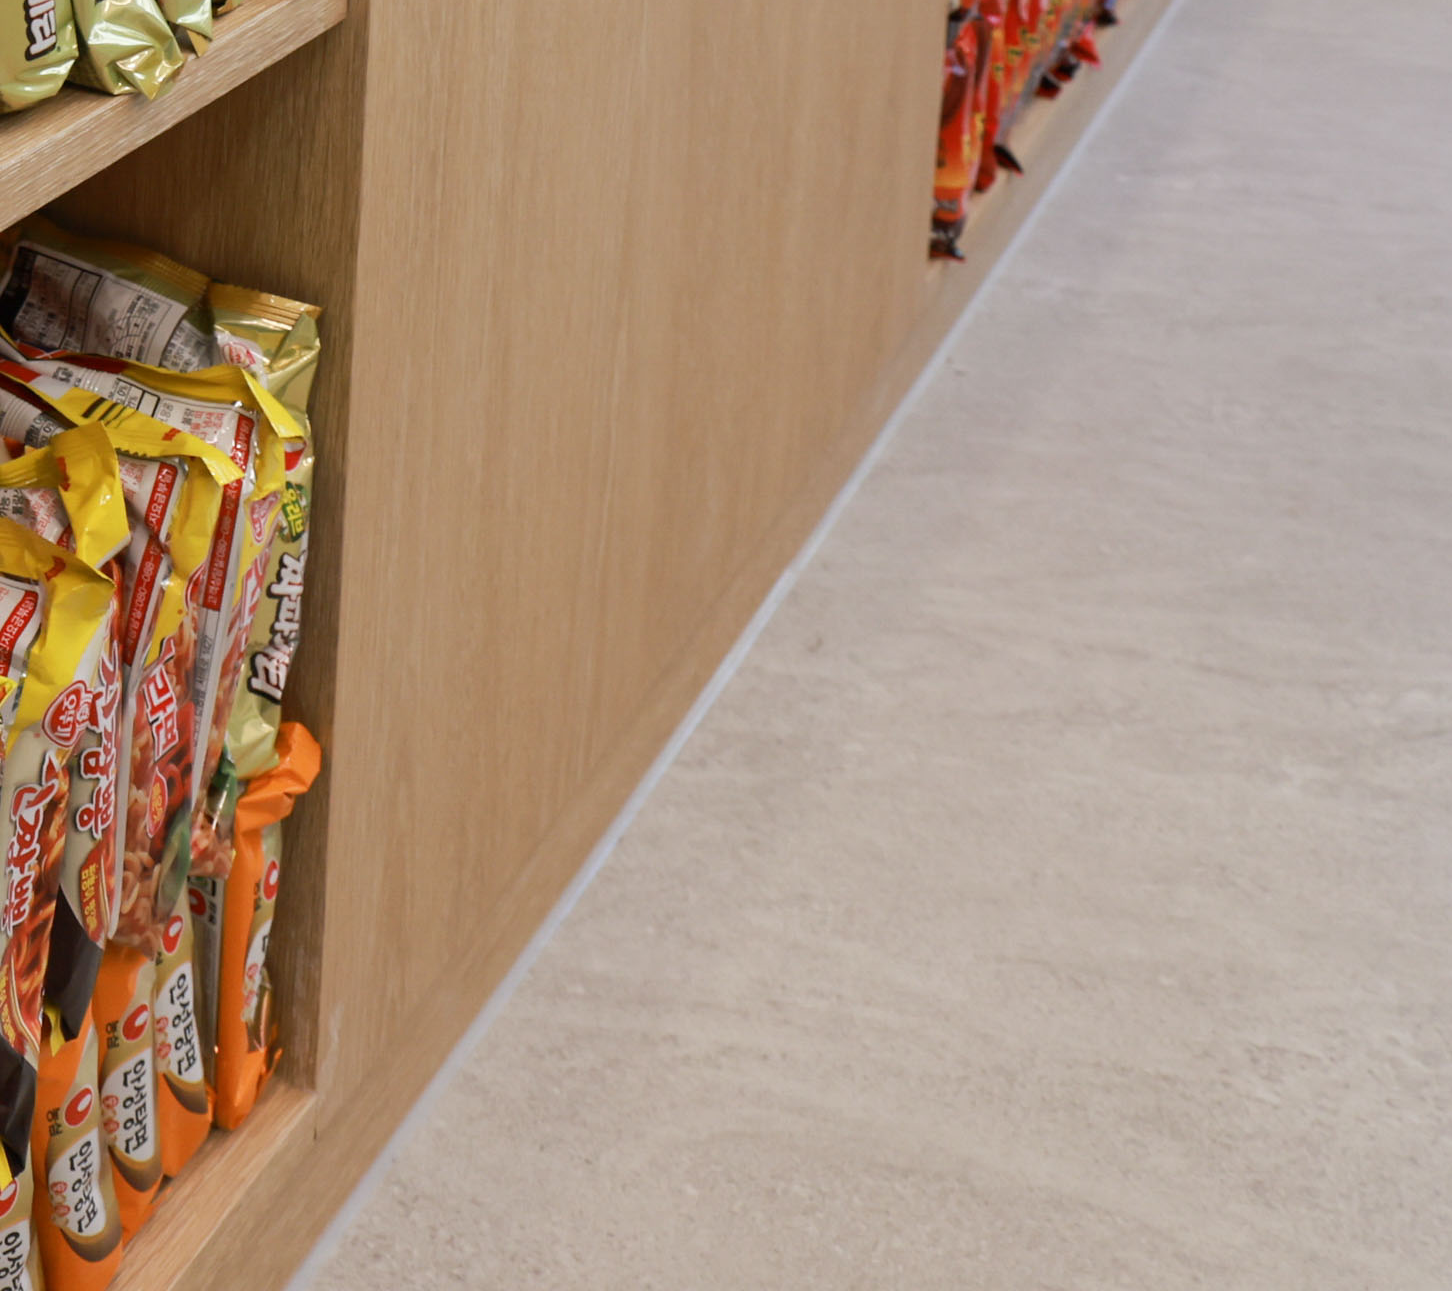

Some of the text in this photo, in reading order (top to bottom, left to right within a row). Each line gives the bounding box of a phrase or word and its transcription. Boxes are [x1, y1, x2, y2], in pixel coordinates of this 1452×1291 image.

[2, 751, 58, 936] 진짬뽕
[169, 972, 197, 1076] 안성탕면
[122, 1059, 148, 1154] 안성탕면
[68, 1140, 98, 1234] 안성탕면
